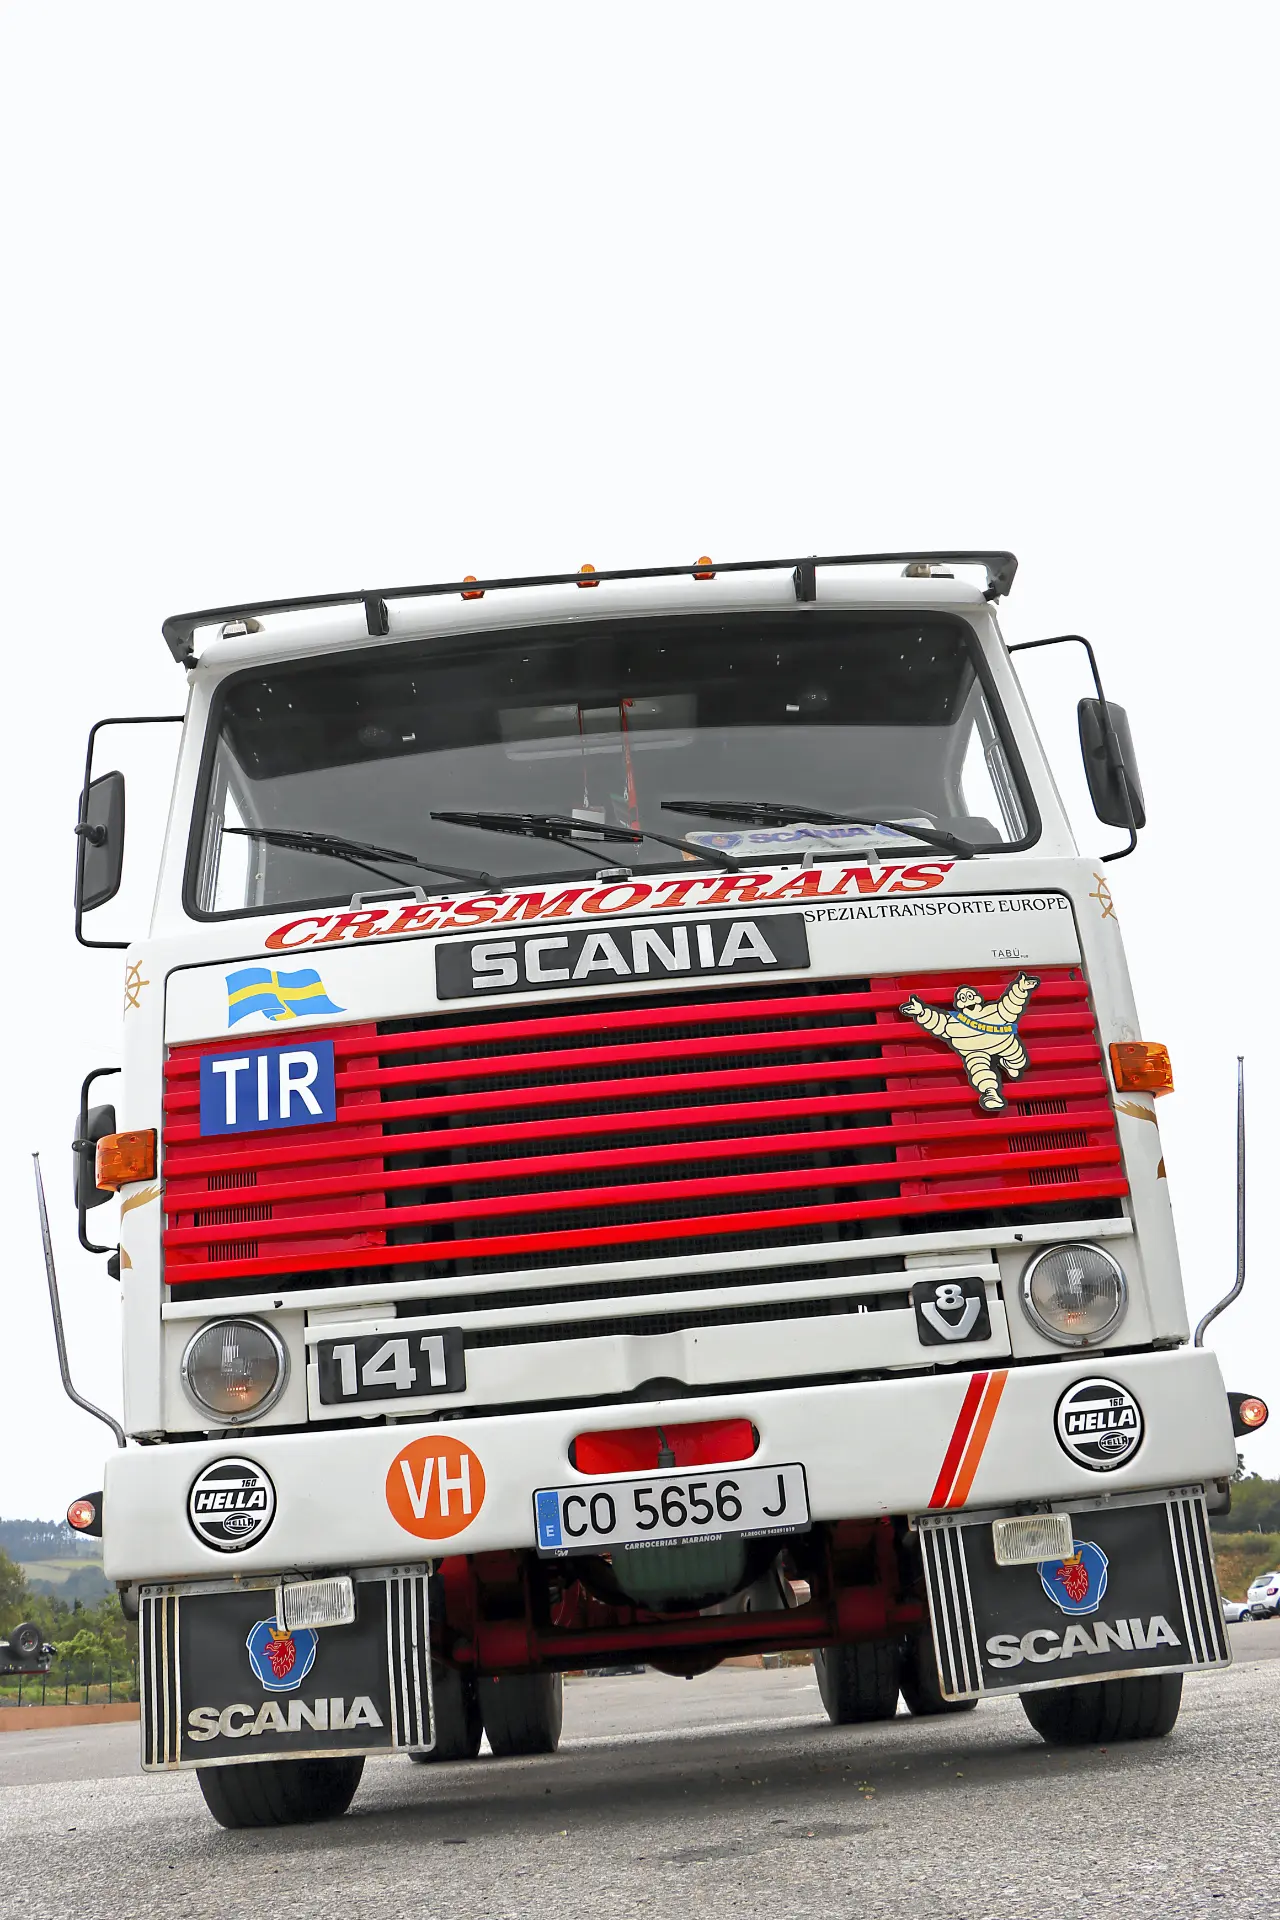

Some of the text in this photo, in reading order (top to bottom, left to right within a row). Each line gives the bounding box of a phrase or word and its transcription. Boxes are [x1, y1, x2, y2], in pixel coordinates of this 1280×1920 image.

[749, 827, 872, 845] SCANIA
[264, 862, 956, 950] CRESMOTRANS
[804, 897, 1068, 923] SPEZIALTRANSPORTE EUROPE
[471, 921, 779, 990] SCANIA
[956, 1013, 1013, 1033] MICHELIN
[211, 1050, 324, 1126] TIR
[332, 1335, 449, 1396] 141
[1109, 1397, 1124, 1407] 160
[1068, 1408, 1135, 1433] HELLA
[1101, 1434, 1128, 1446] HELLA
[241, 1478, 258, 1488] 160
[399, 1454, 473, 1520] VH
[196, 1490, 265, 1511] HELLA
[562, 1474, 787, 1537] CO 5656 J
[225, 1517, 254, 1527] HELLA
[545, 1524, 555, 1537] E
[624, 1539, 678, 1551] CARROCERIAS
[986, 1615, 1182, 1669] SCANIA
[187, 1695, 384, 1742] SCANIA
